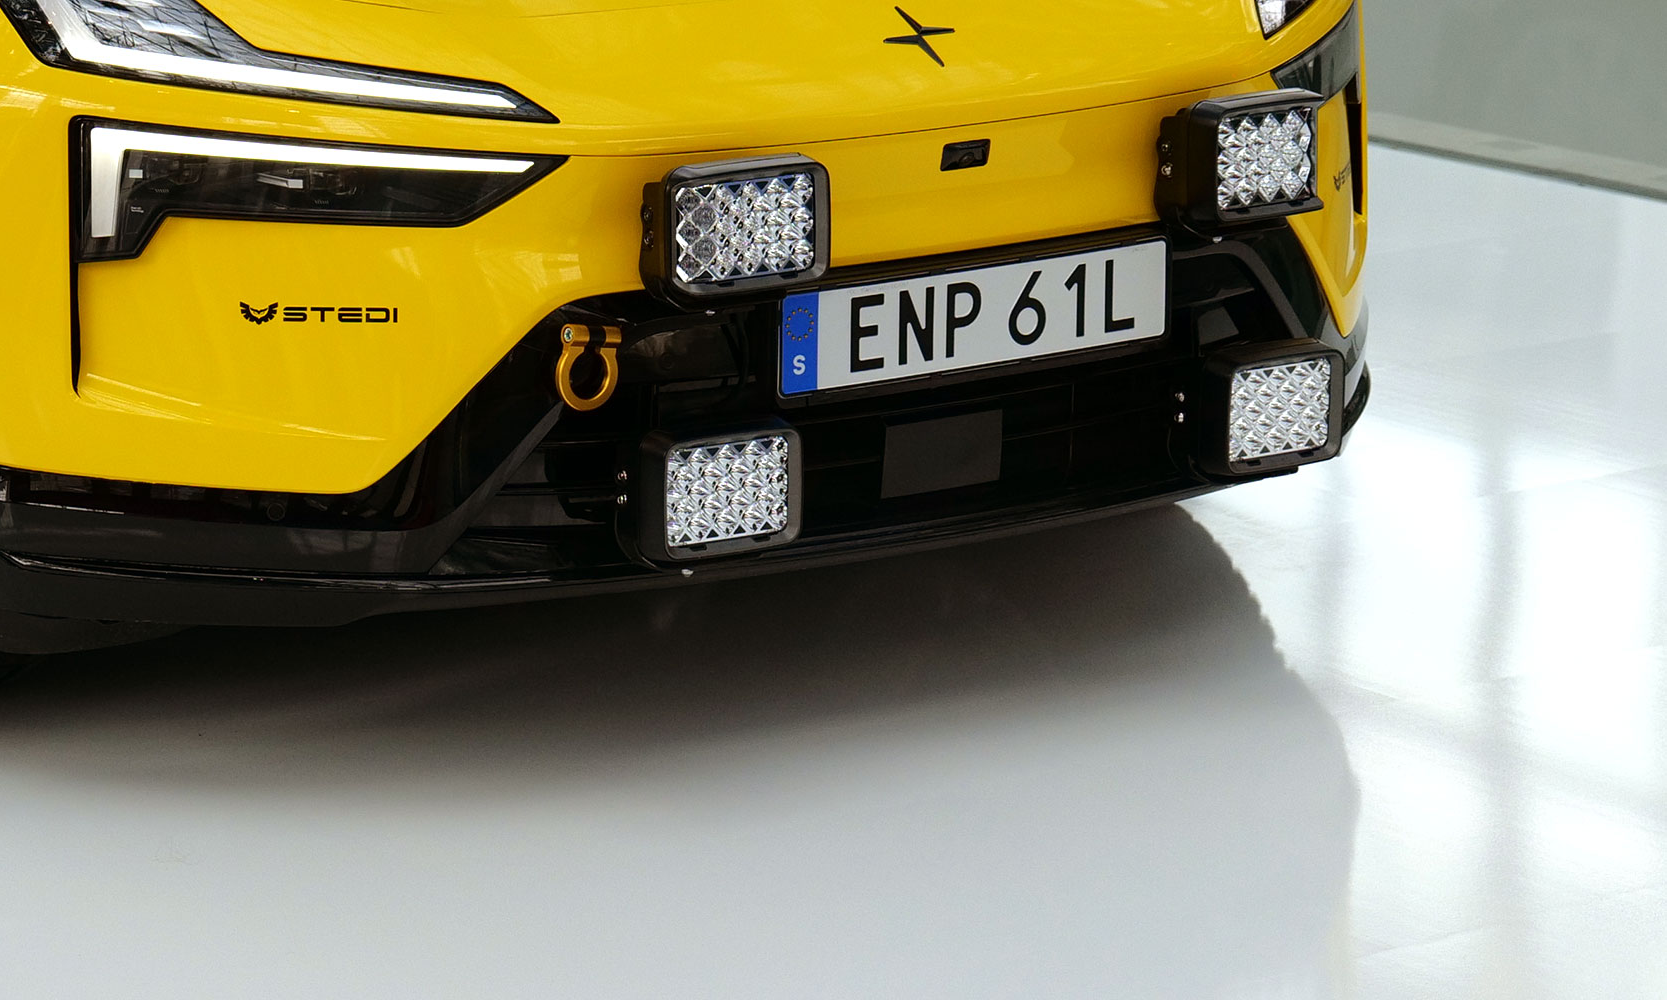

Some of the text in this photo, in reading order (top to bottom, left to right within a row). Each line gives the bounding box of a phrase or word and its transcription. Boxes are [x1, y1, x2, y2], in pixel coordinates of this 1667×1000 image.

[283, 306, 399, 324] STEDI
[850, 259, 1135, 373] ENP 61L
[792, 354, 807, 376] S
